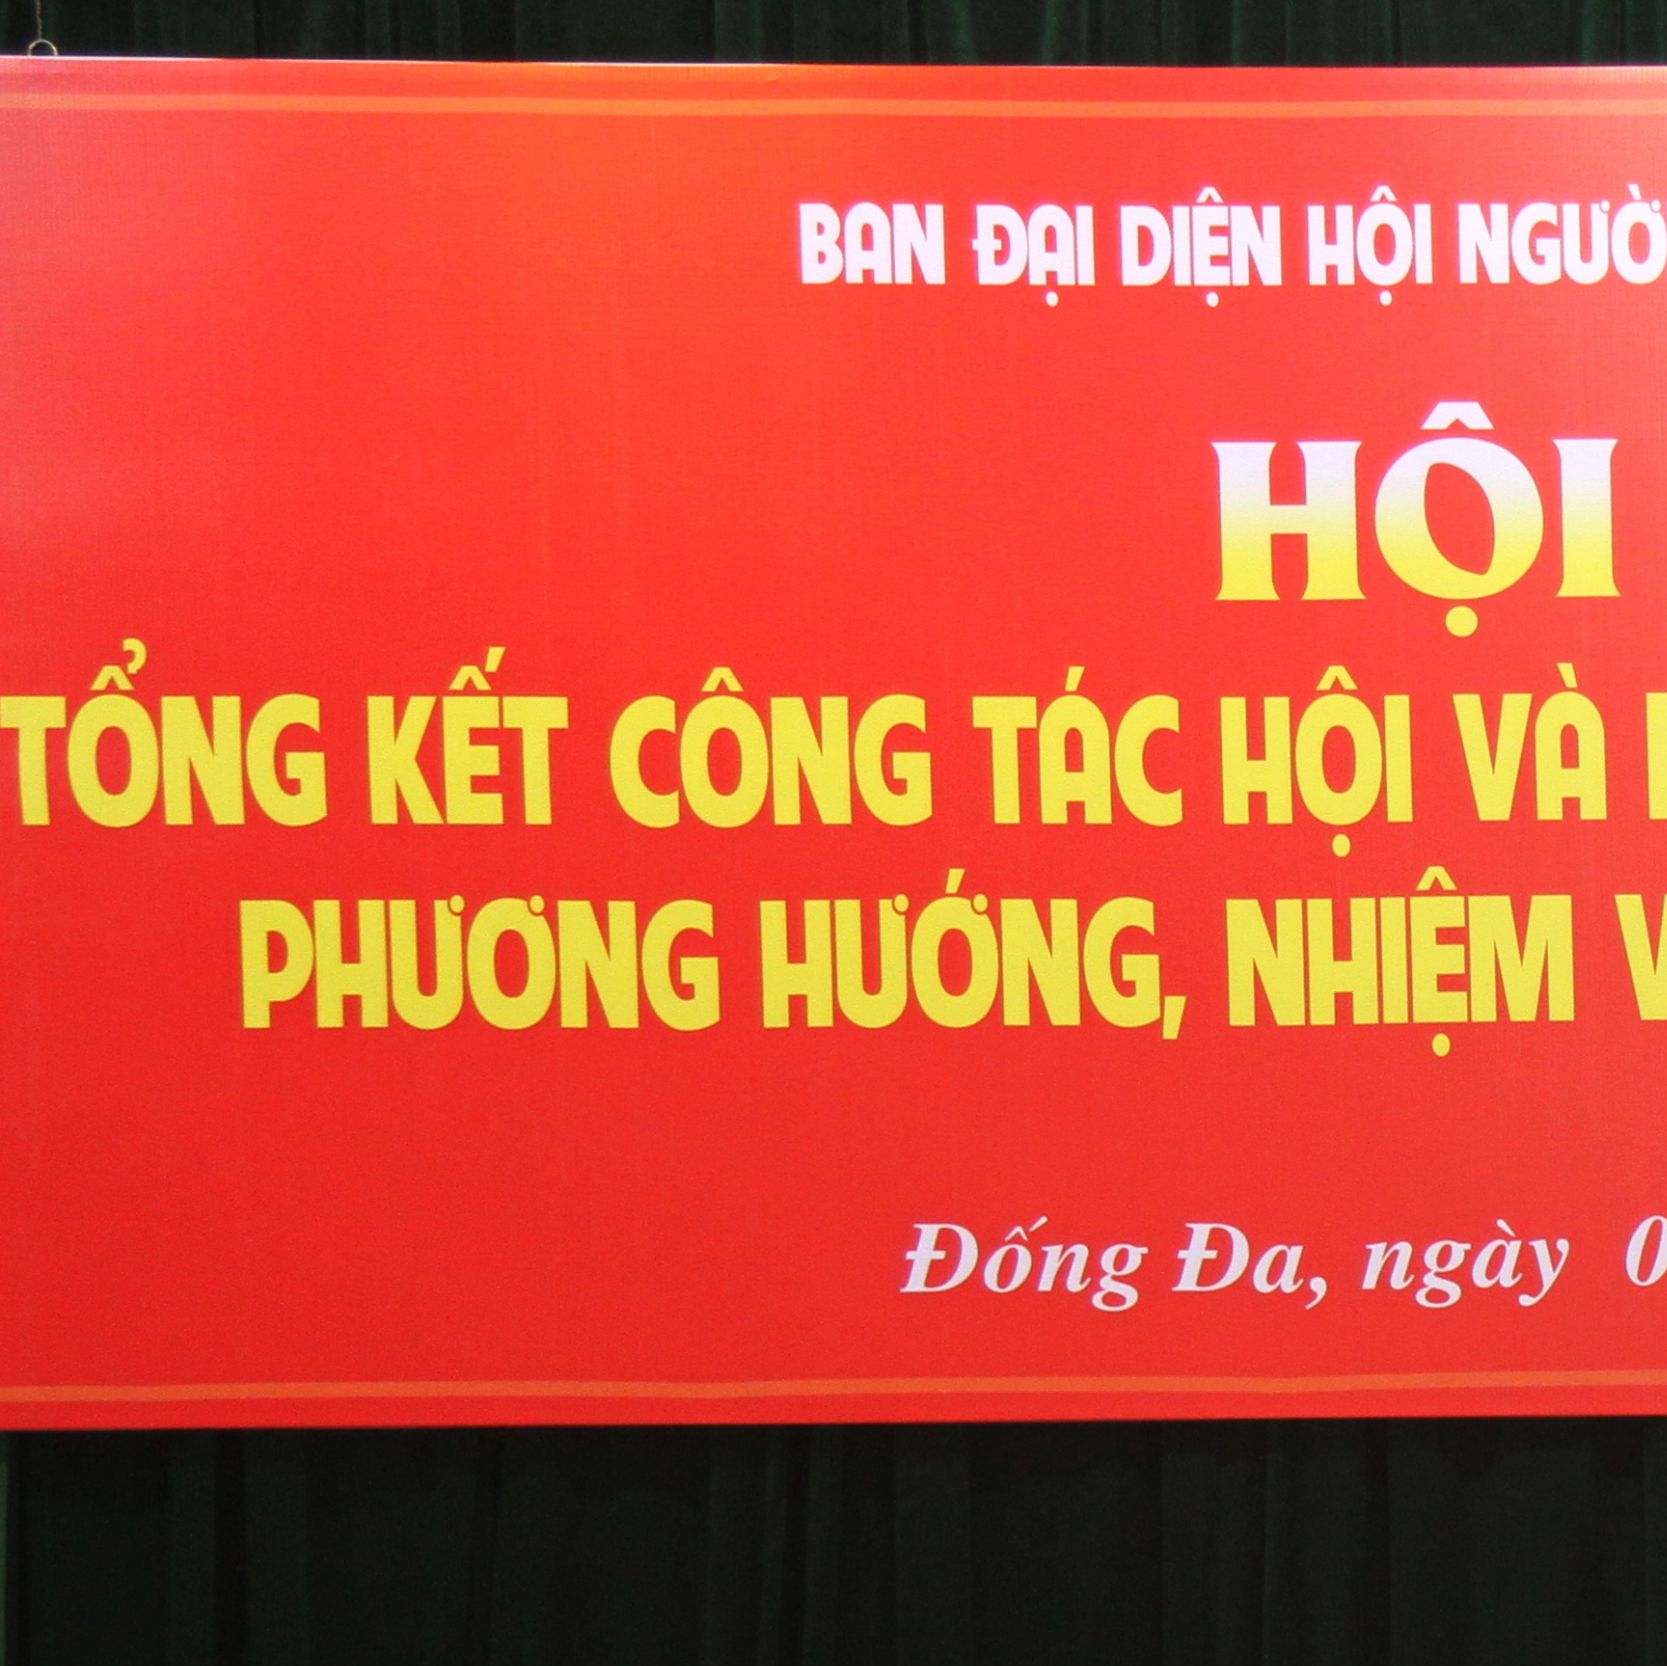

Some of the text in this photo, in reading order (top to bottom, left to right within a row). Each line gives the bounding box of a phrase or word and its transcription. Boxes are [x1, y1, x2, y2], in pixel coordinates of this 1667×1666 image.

[800, 203, 945, 284] BAN
[973, 205, 1094, 306] ĐẠI
[1121, 187, 1281, 306] DIỆN
[1308, 186, 1432, 305] HỘI
[1212, 402, 1620, 637] HỘI
[0, 638, 327, 827] TỔNG
[368, 647, 568, 824] KẾT
[610, 667, 932, 828] CÔNG
[972, 666, 1183, 826] TÁC
[1221, 665, 1413, 857] HỘI
[1453, 663, 1607, 821] VÀ
[240, 896, 719, 1030] PHƯƠNG
[760, 869, 1186, 1039] HƯỚNG,
[1226, 866, 1574, 1056] NHIỆM
[901, 1217, 1148, 1311] Đống
[1173, 1224, 1326, 1308] Đa,
[1363, 1220, 1569, 1307] ngày
